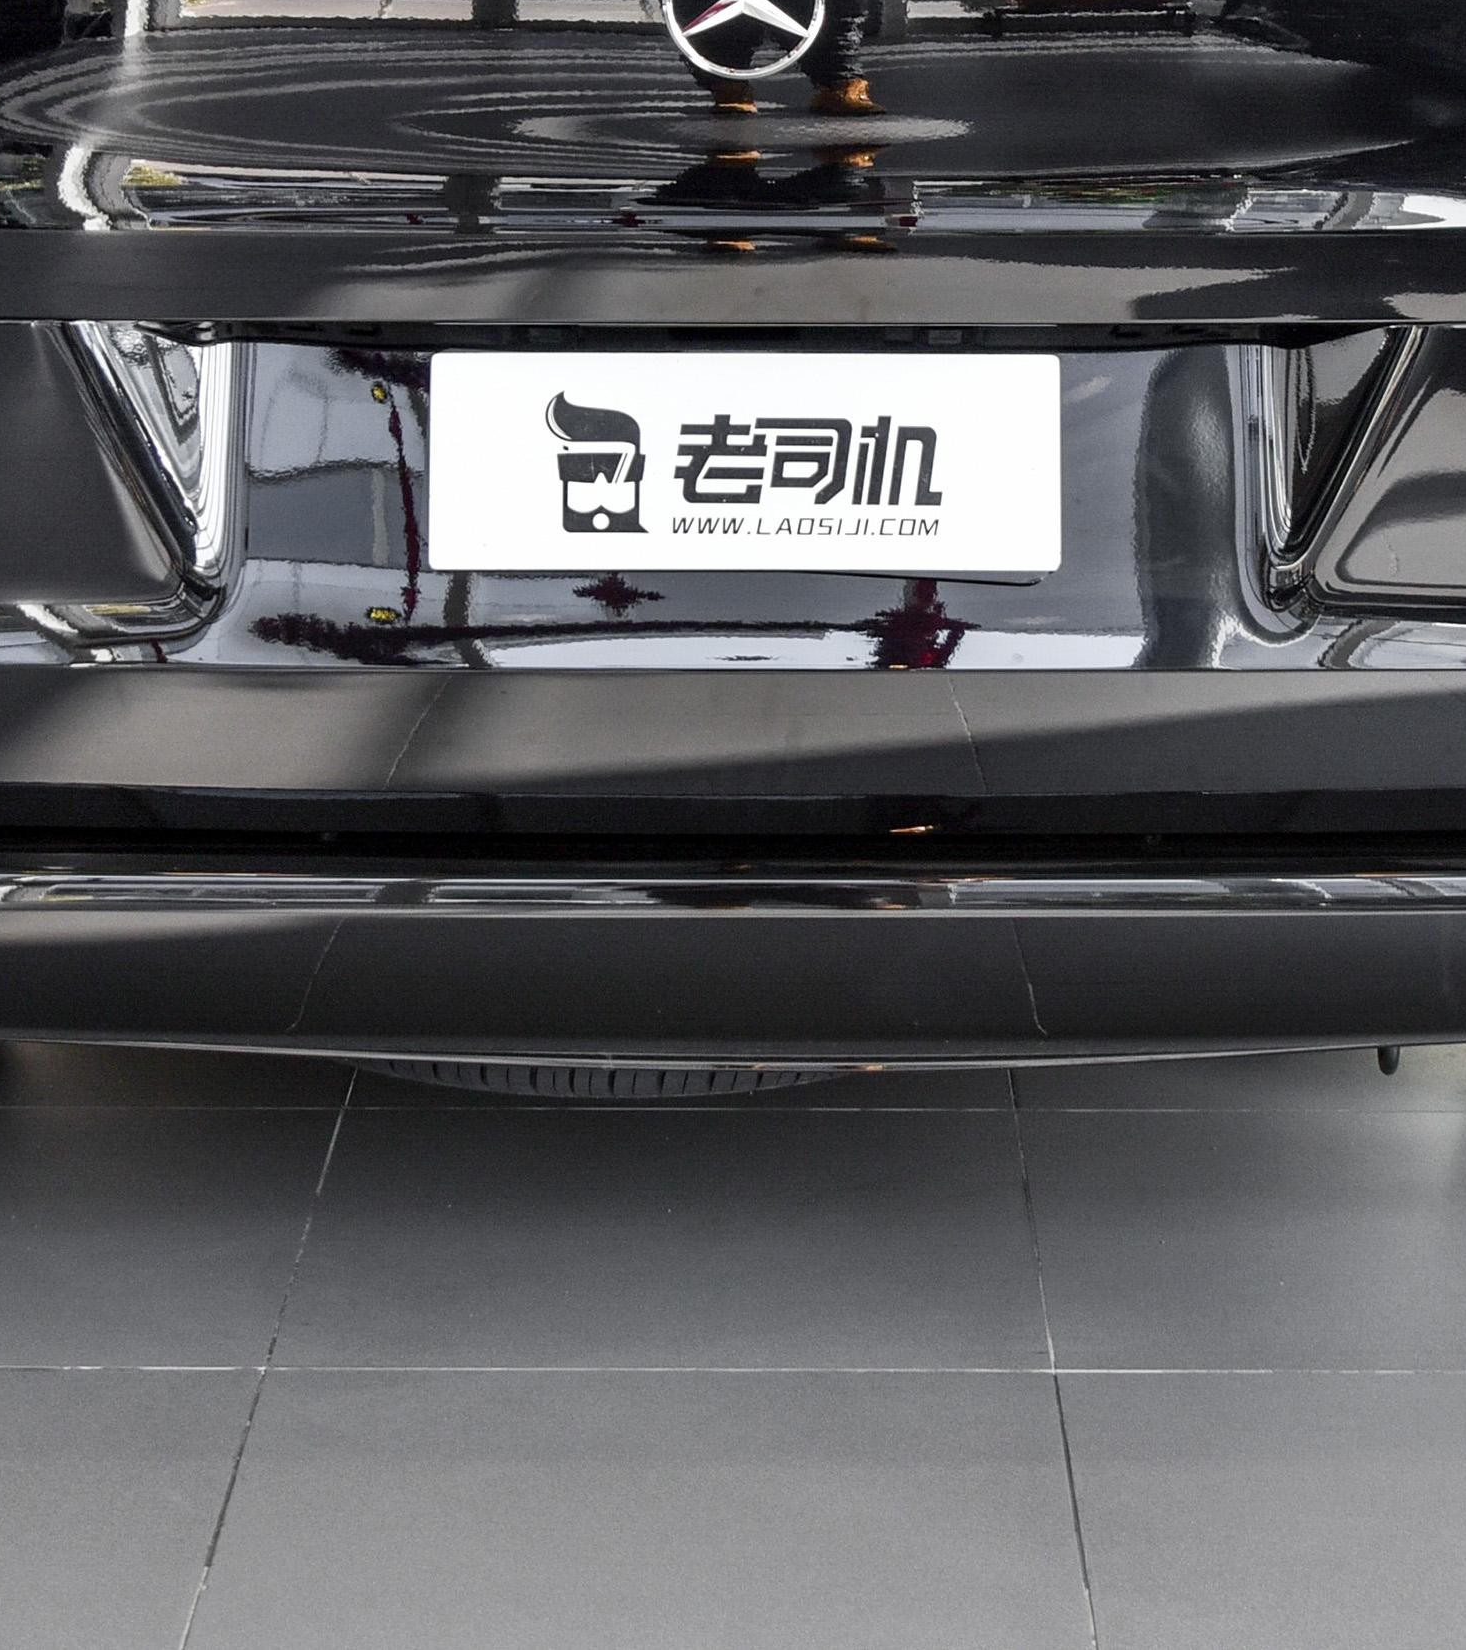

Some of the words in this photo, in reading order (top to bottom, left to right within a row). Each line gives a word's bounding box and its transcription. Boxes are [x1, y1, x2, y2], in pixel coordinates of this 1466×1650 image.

[674, 414, 943, 505] 老司机
[671, 516, 940, 537] WWW.LAOSIJI.COM
